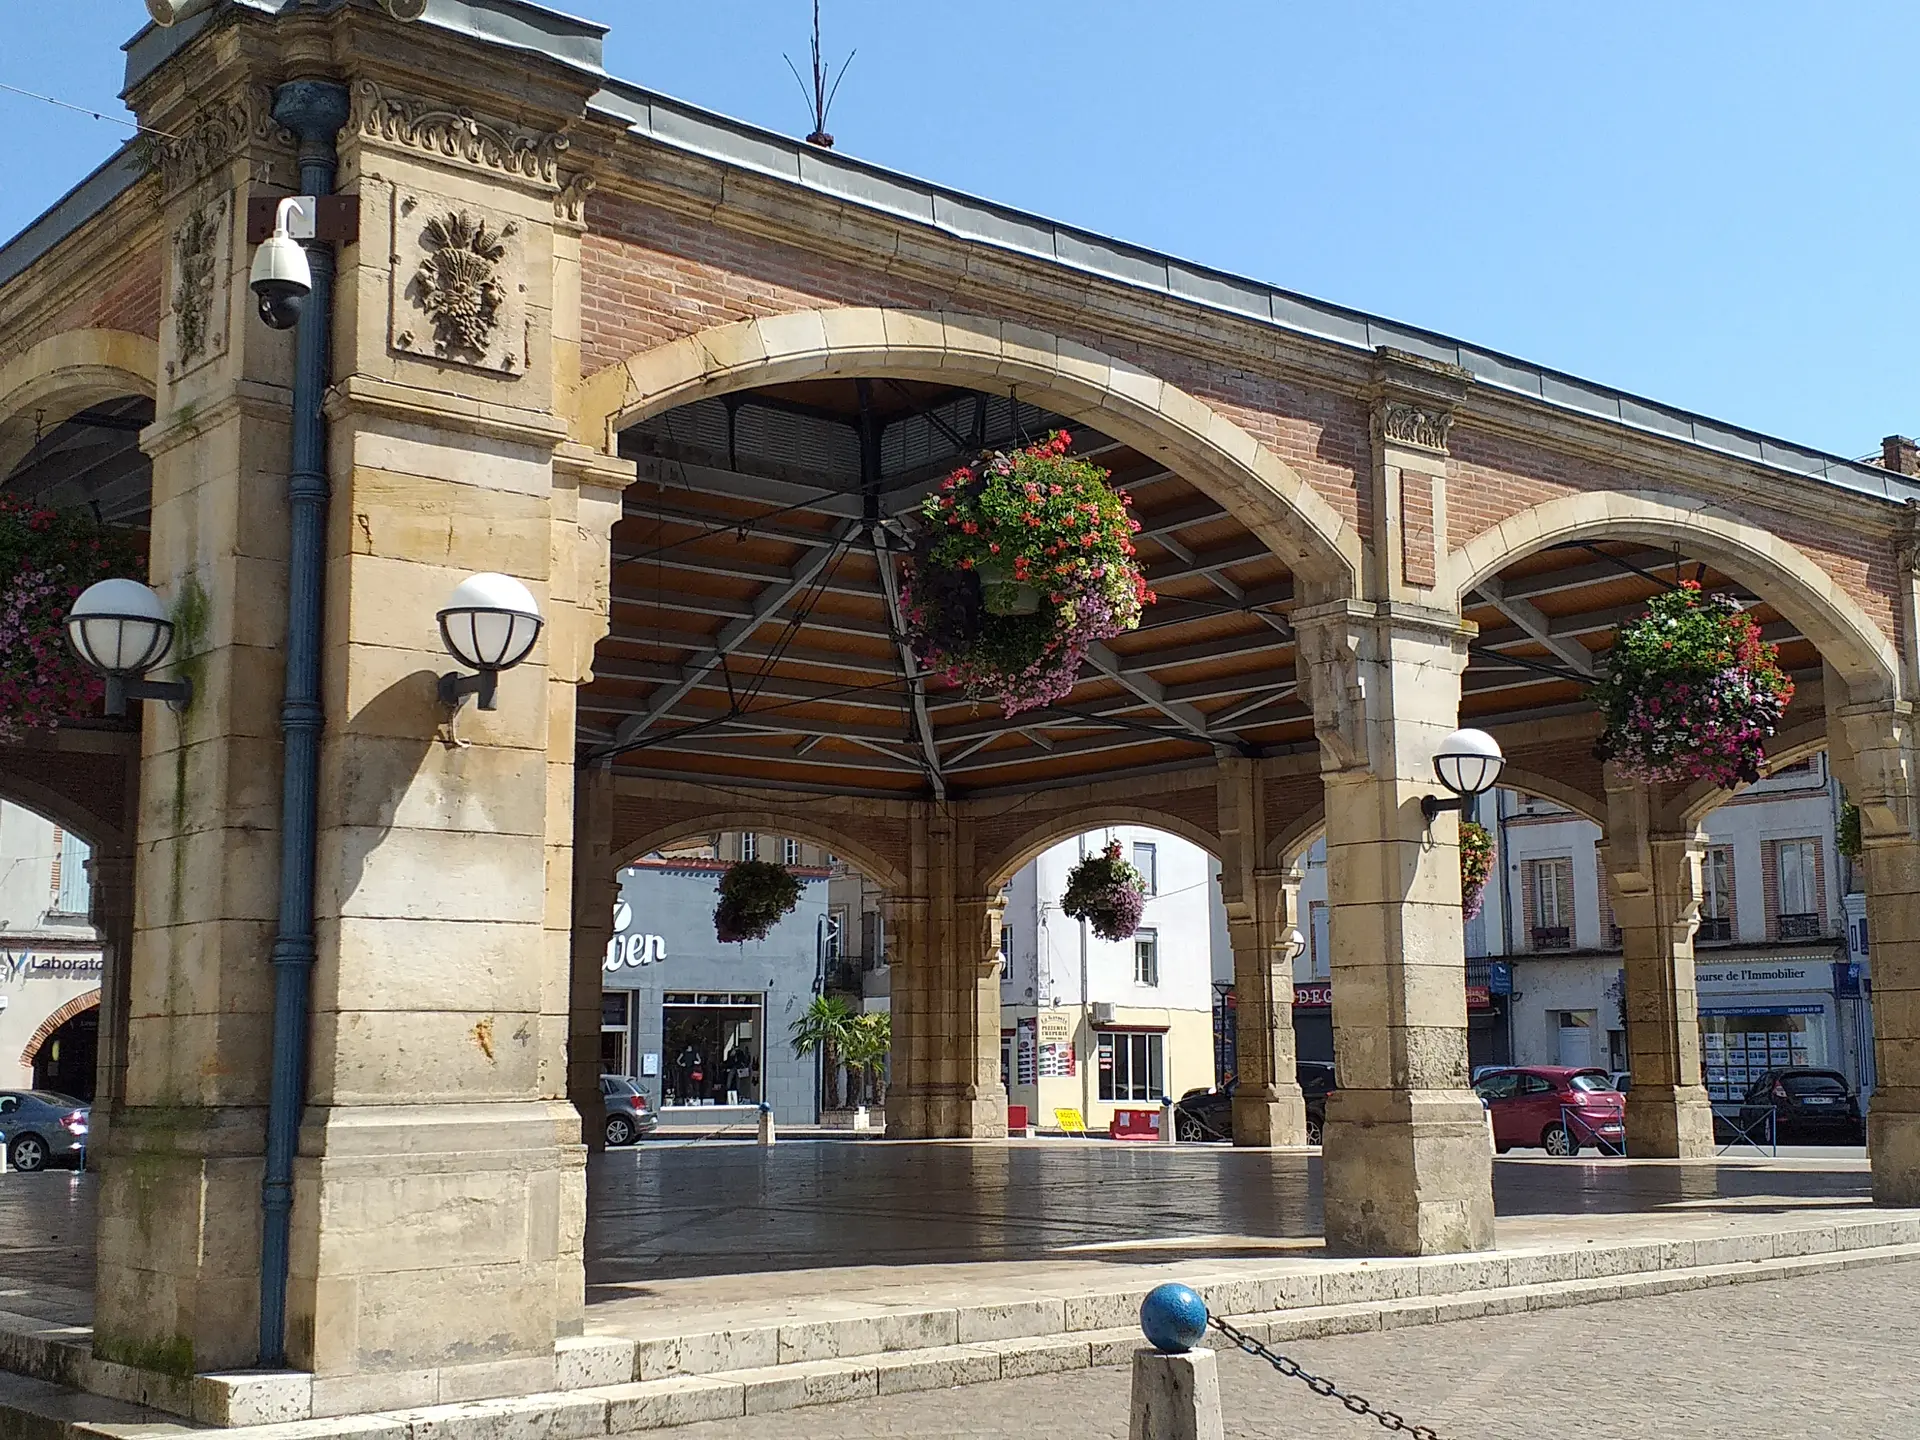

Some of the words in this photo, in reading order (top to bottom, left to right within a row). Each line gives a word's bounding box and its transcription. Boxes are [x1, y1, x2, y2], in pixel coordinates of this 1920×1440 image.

[1695, 972, 1723, 982] ourse
[1726, 970, 1739, 981] de
[1741, 968, 1805, 980] l'Immobilier
